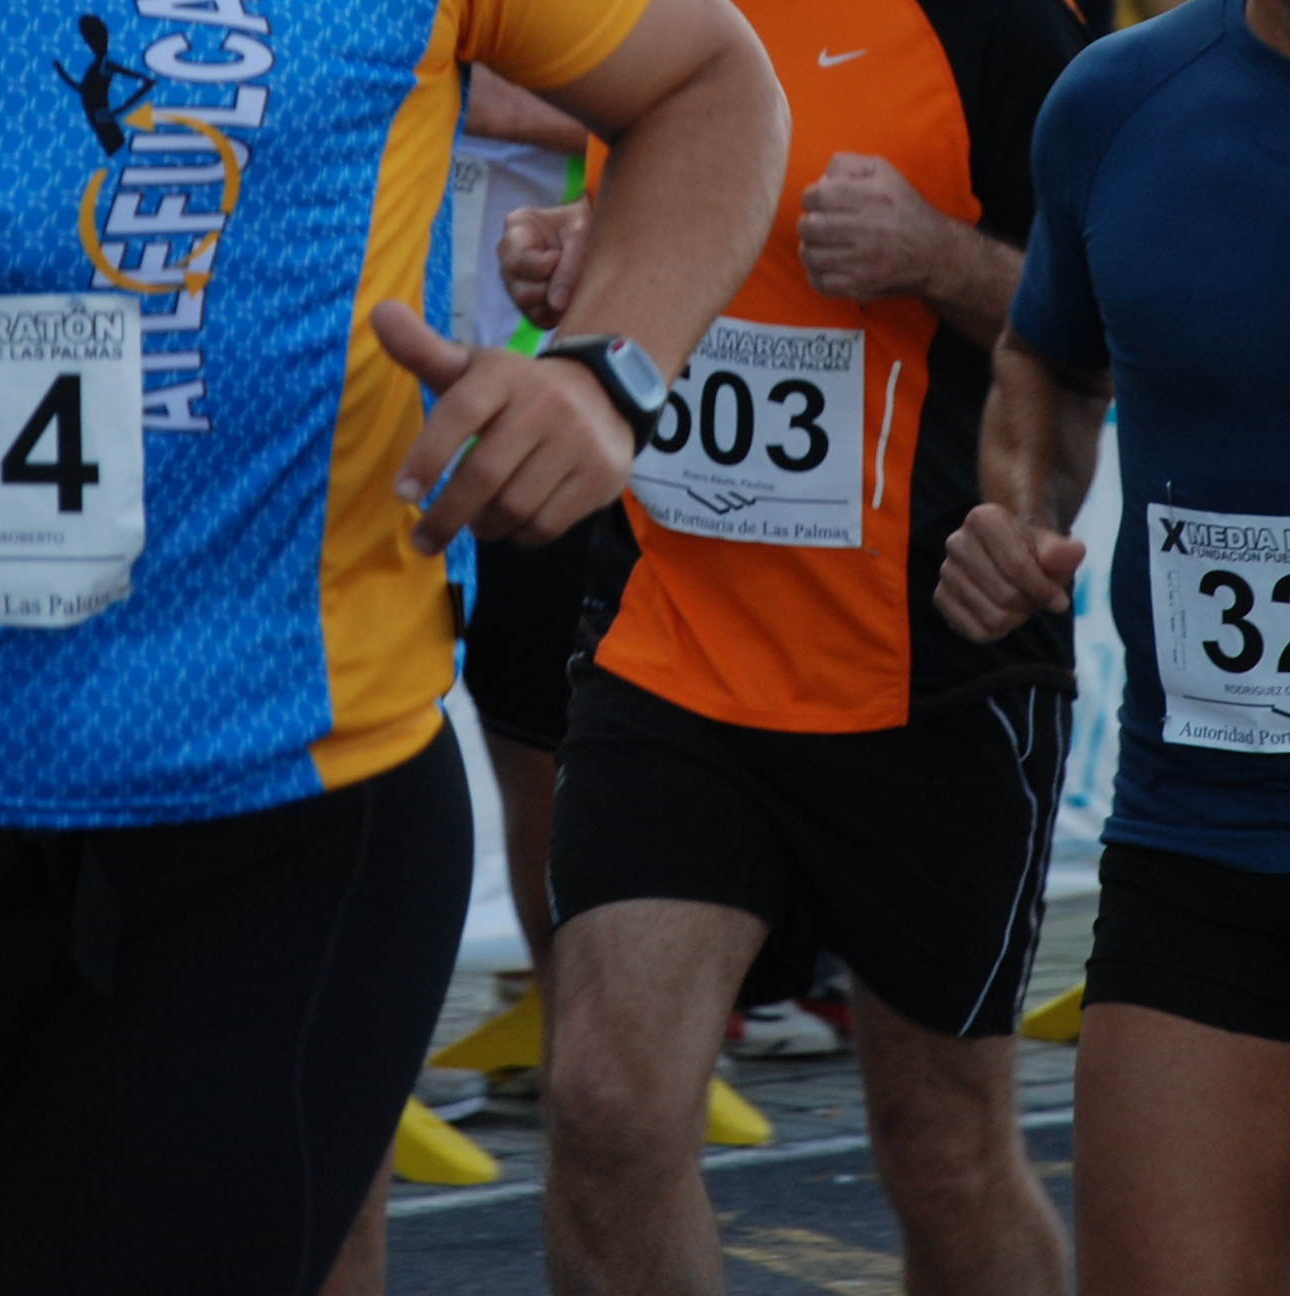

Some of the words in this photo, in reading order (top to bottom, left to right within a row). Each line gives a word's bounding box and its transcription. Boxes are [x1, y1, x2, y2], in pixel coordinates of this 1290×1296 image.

[11, 345, 45, 361] LAS
[51, 345, 124, 361] PALMAS
[716, 326, 853, 363] MARATÓN
[673, 509, 734, 534] Portuaria
[738, 519, 756, 534] de
[762, 521, 789, 538] Las
[794, 523, 850, 541] Palmas
[1159, 517, 1189, 555] X
[1187, 521, 1279, 553] MEDIA
[4, 592, 41, 617] Las
[1178, 719, 1255, 746] Autoridad
